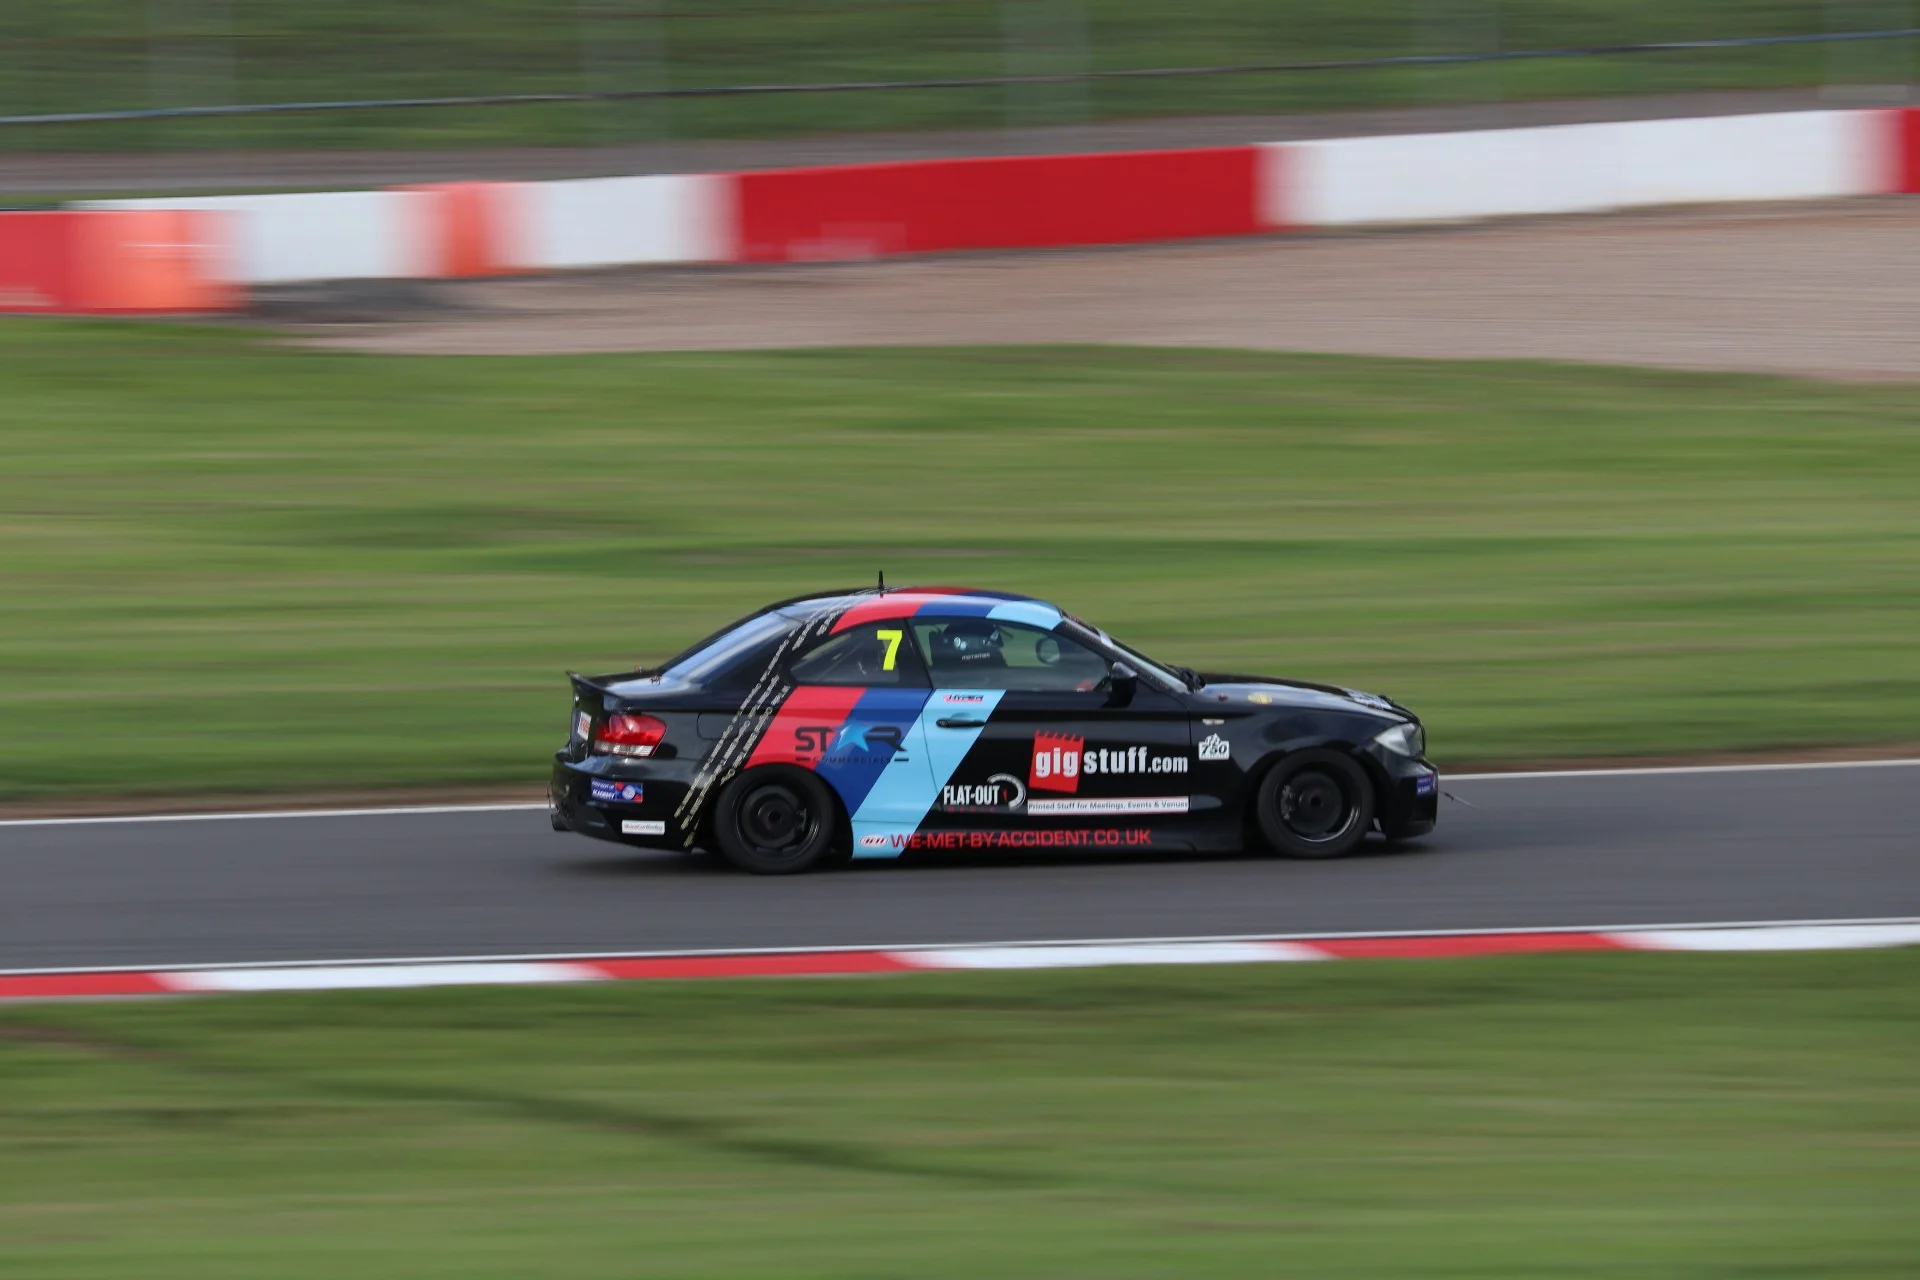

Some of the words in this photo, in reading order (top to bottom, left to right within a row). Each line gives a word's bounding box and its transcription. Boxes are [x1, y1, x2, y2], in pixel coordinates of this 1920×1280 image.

[877, 629, 903, 671] 7
[943, 785, 1000, 805] FLAT-OUT
[1028, 803, 1055, 811] Printed
[1056, 801, 1076, 810] Stuff
[1077, 801, 1088, 809] for
[1127, 800, 1152, 809] Events
[890, 829, 1153, 849] WE-MET-BY-ACCIDENT.CO.UK
